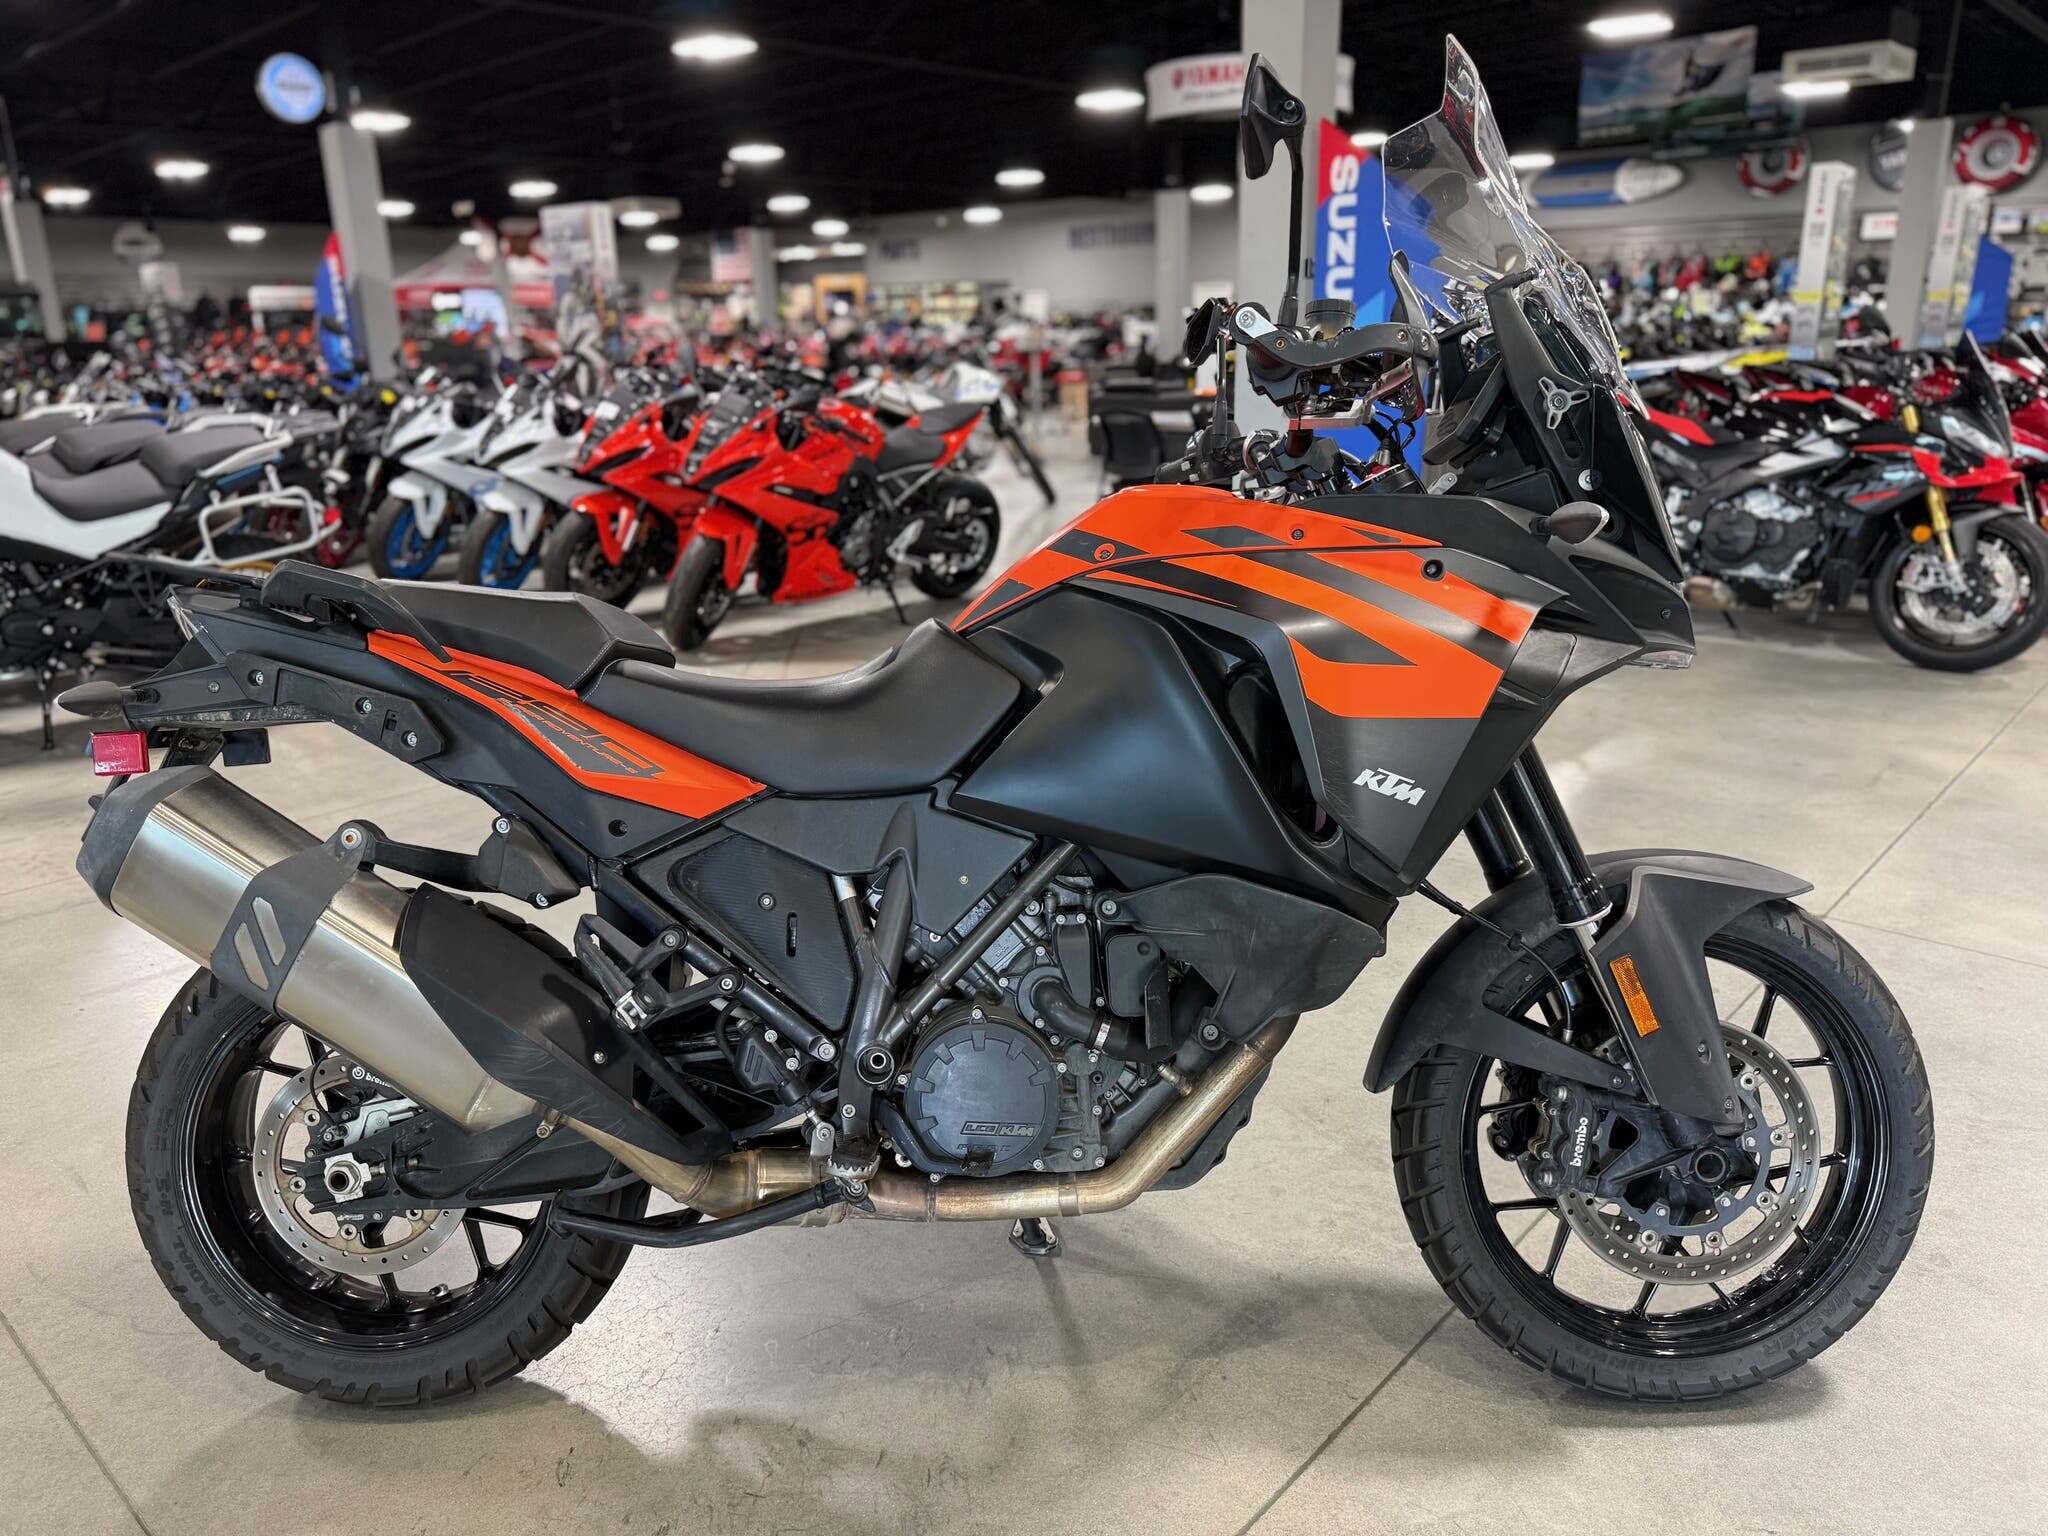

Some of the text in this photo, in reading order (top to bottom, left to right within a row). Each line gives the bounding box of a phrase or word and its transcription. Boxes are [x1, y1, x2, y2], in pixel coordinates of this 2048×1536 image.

[1324, 154, 1359, 300] SUZU
[1352, 767, 1427, 806] KTM
[1568, 1116, 1590, 1167] brembo
[1760, 1285, 1855, 1359] MASTER
